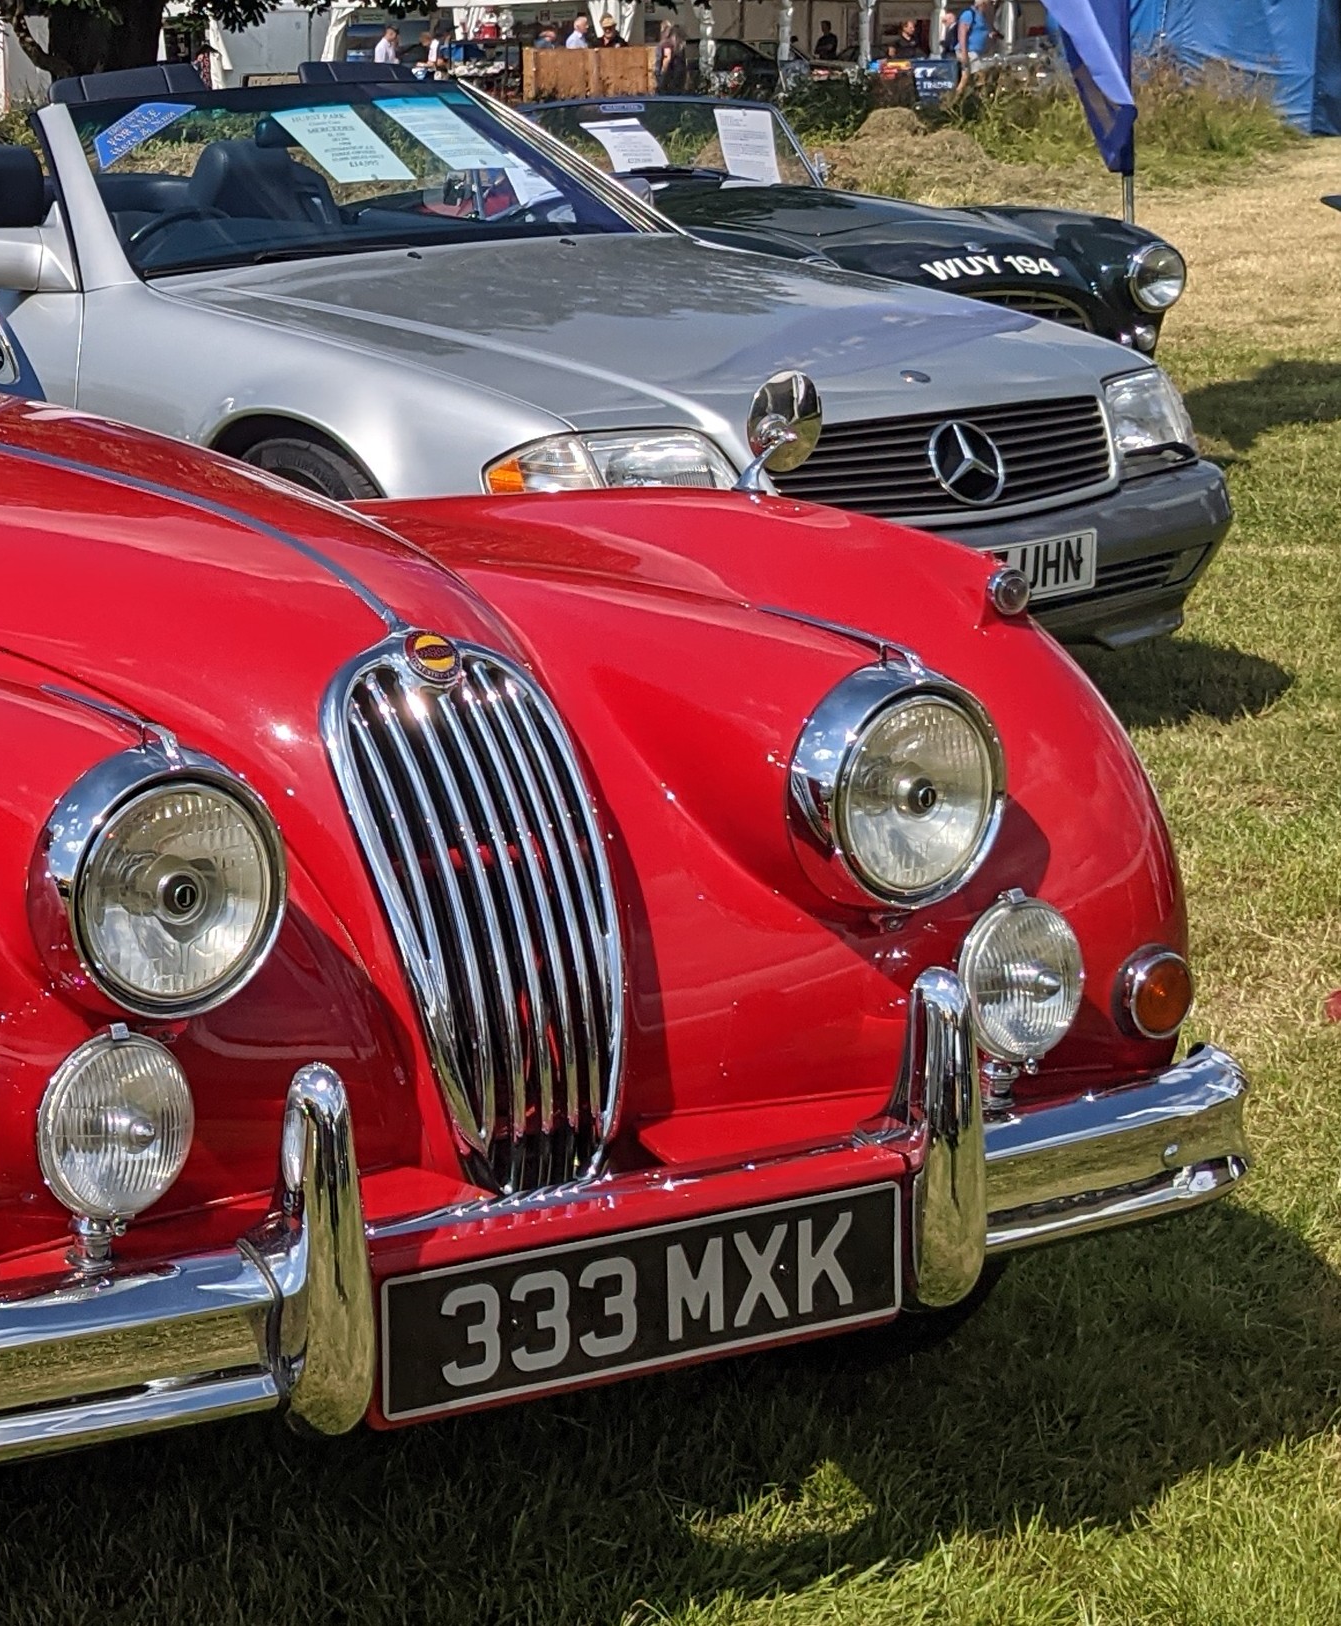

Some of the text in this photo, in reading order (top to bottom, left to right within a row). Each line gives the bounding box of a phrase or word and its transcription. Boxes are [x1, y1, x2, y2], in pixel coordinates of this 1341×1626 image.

[307, 125, 355, 134] MERCEDES
[919, 255, 1061, 281] WUY 194
[440, 1211, 854, 1386] 333 MXK
